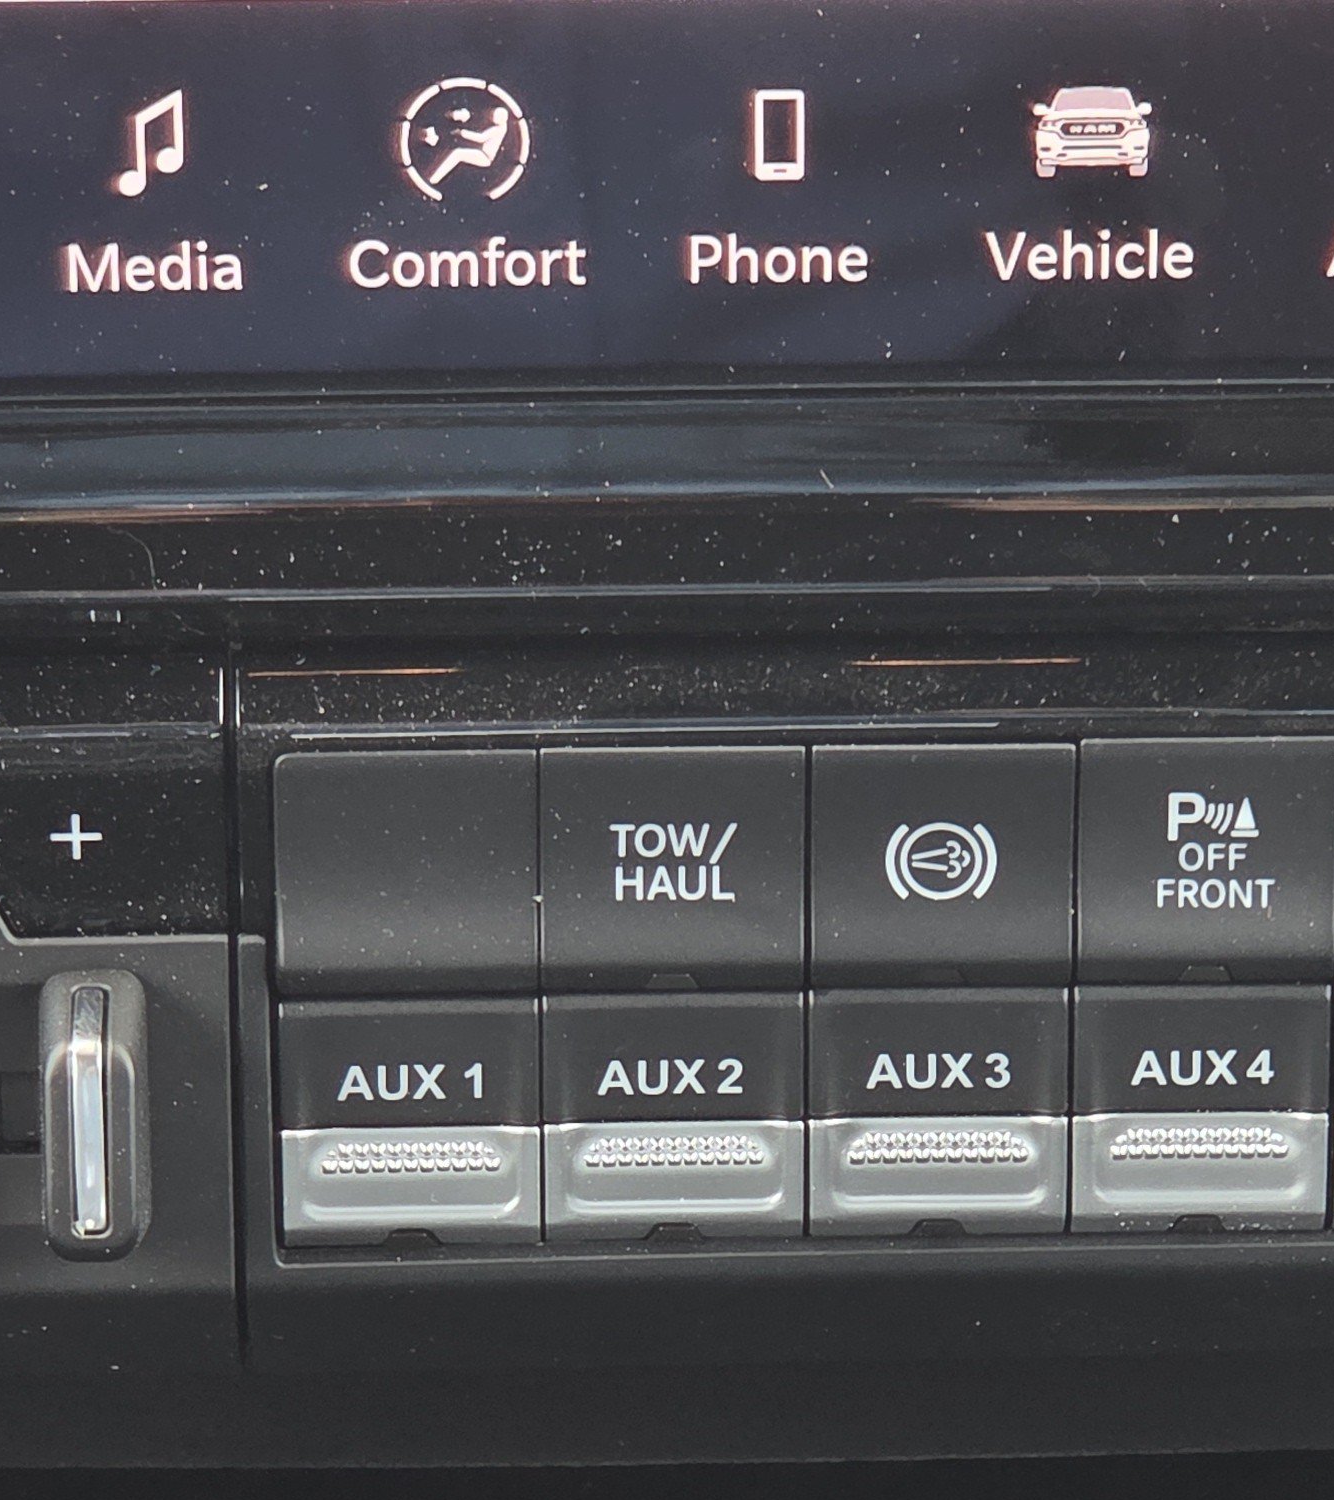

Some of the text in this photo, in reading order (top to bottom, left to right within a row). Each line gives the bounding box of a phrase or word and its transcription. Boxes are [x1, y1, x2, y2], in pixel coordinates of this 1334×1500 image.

[65, 240, 243, 293] Media
[348, 236, 587, 288] Comfort
[689, 232, 868, 284] Phone
[985, 228, 1194, 281] Vehicle
[1167, 792, 1207, 842] P
[609, 821, 739, 865] TOW/
[1178, 842, 1248, 872] OFF
[615, 865, 736, 903] HAUL
[1156, 878, 1276, 909] FRONT
[337, 1062, 483, 1102] AUX 1
[597, 1058, 743, 1096] AUX 2
[866, 1052, 1011, 1090] AUX 3
[1130, 1049, 1275, 1086] AUX 4
